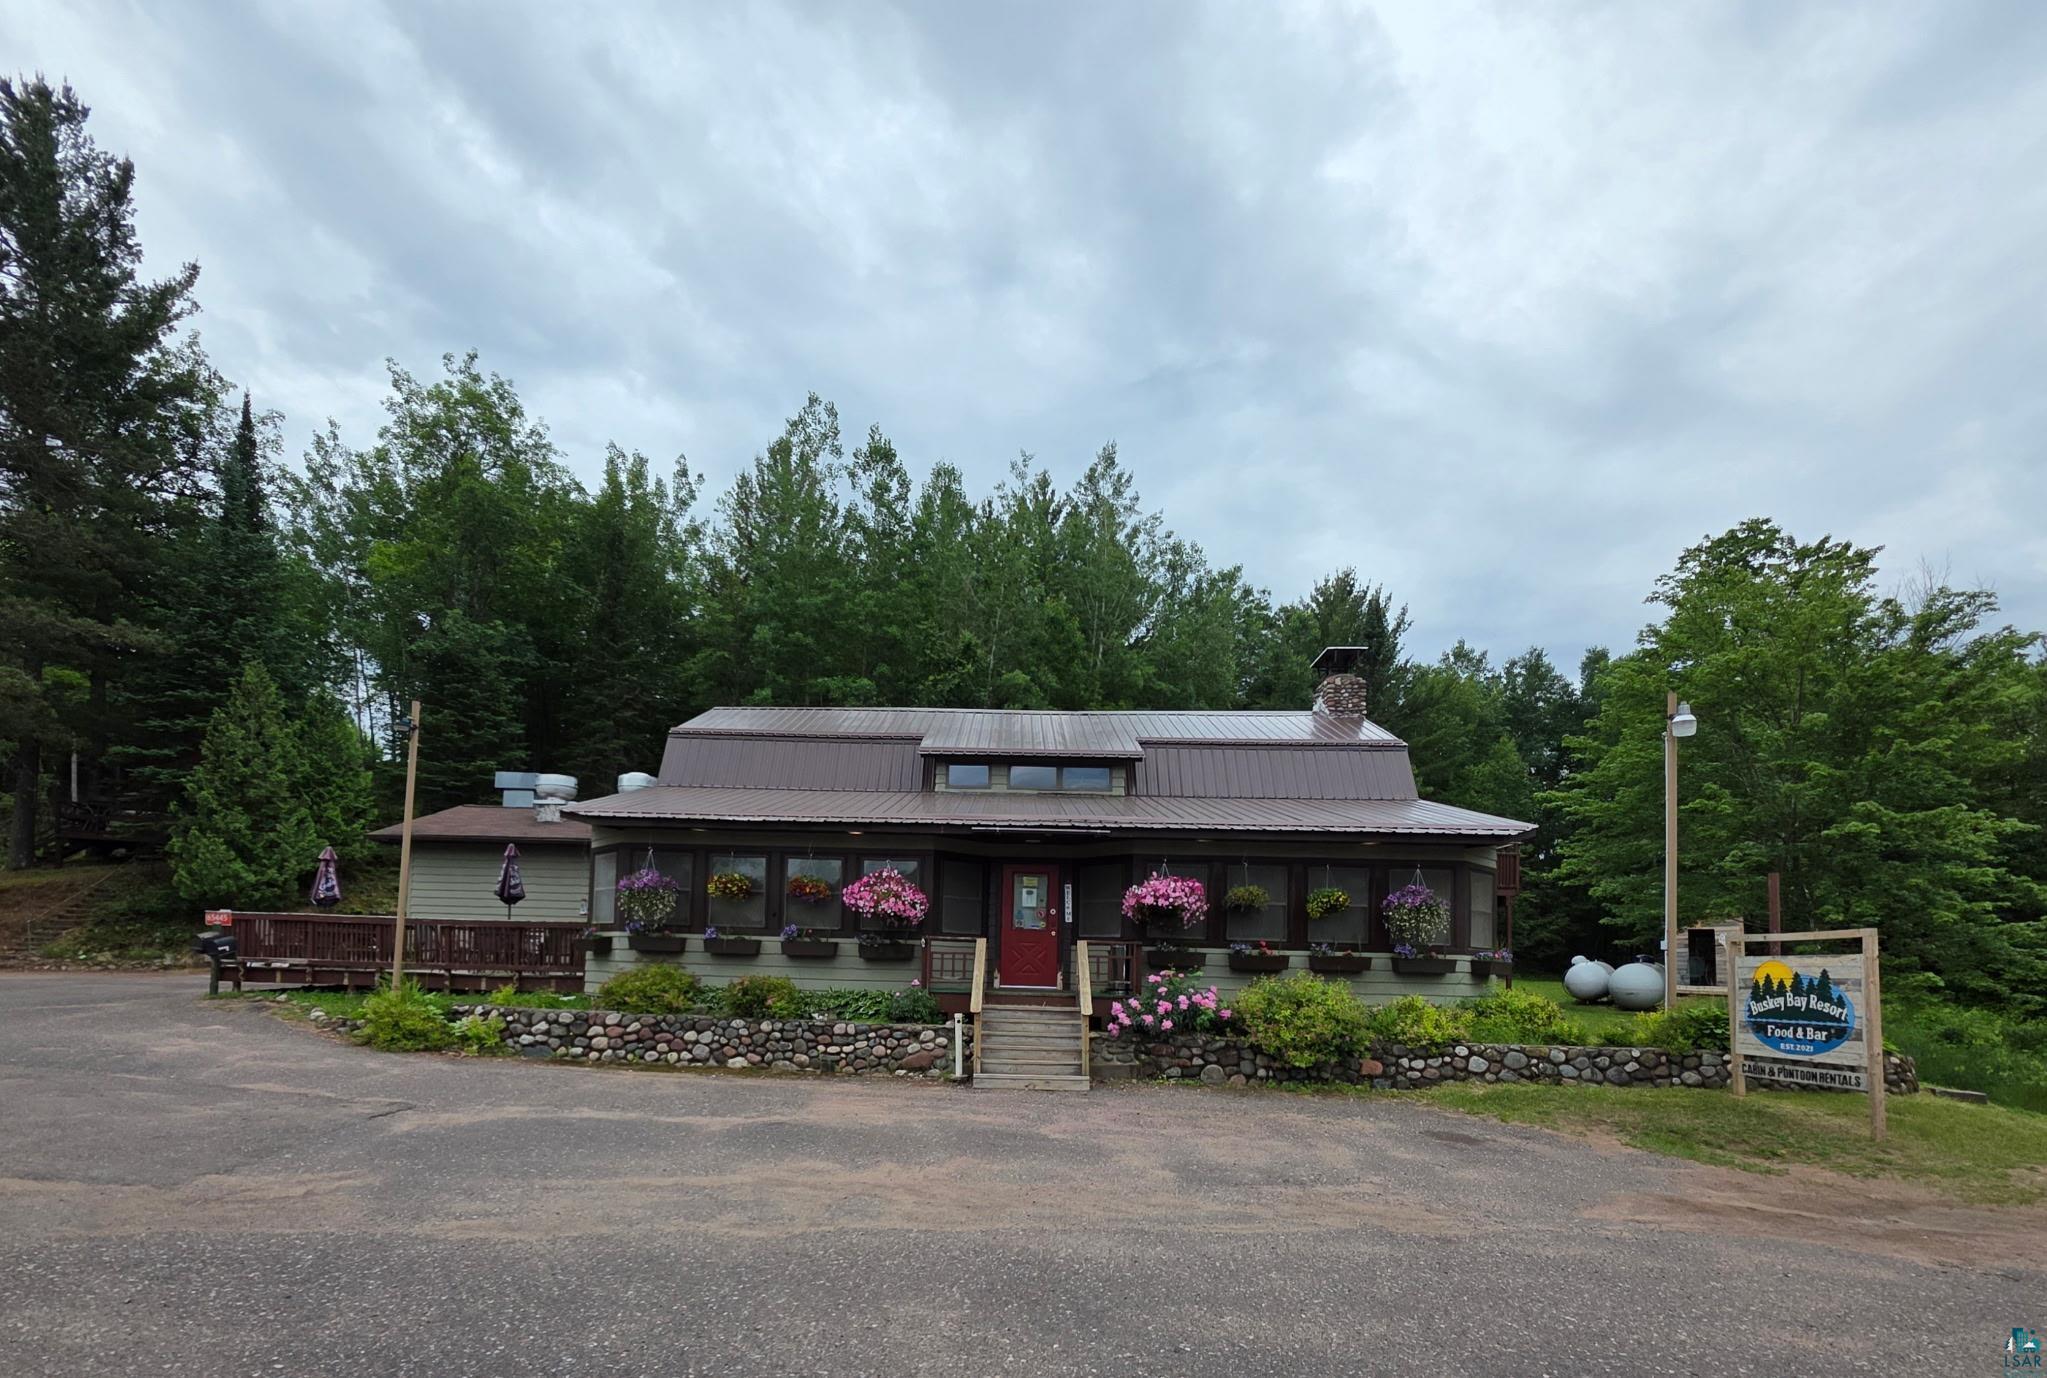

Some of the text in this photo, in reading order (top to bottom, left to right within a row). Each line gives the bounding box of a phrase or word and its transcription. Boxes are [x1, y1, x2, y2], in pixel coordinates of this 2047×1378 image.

[1750, 992, 1848, 1021] Buskey Bay Resort
[1767, 1025, 1828, 1041] Food & Bar
[1742, 1063, 1861, 1087] CABIN & PONTOON RENTALS
